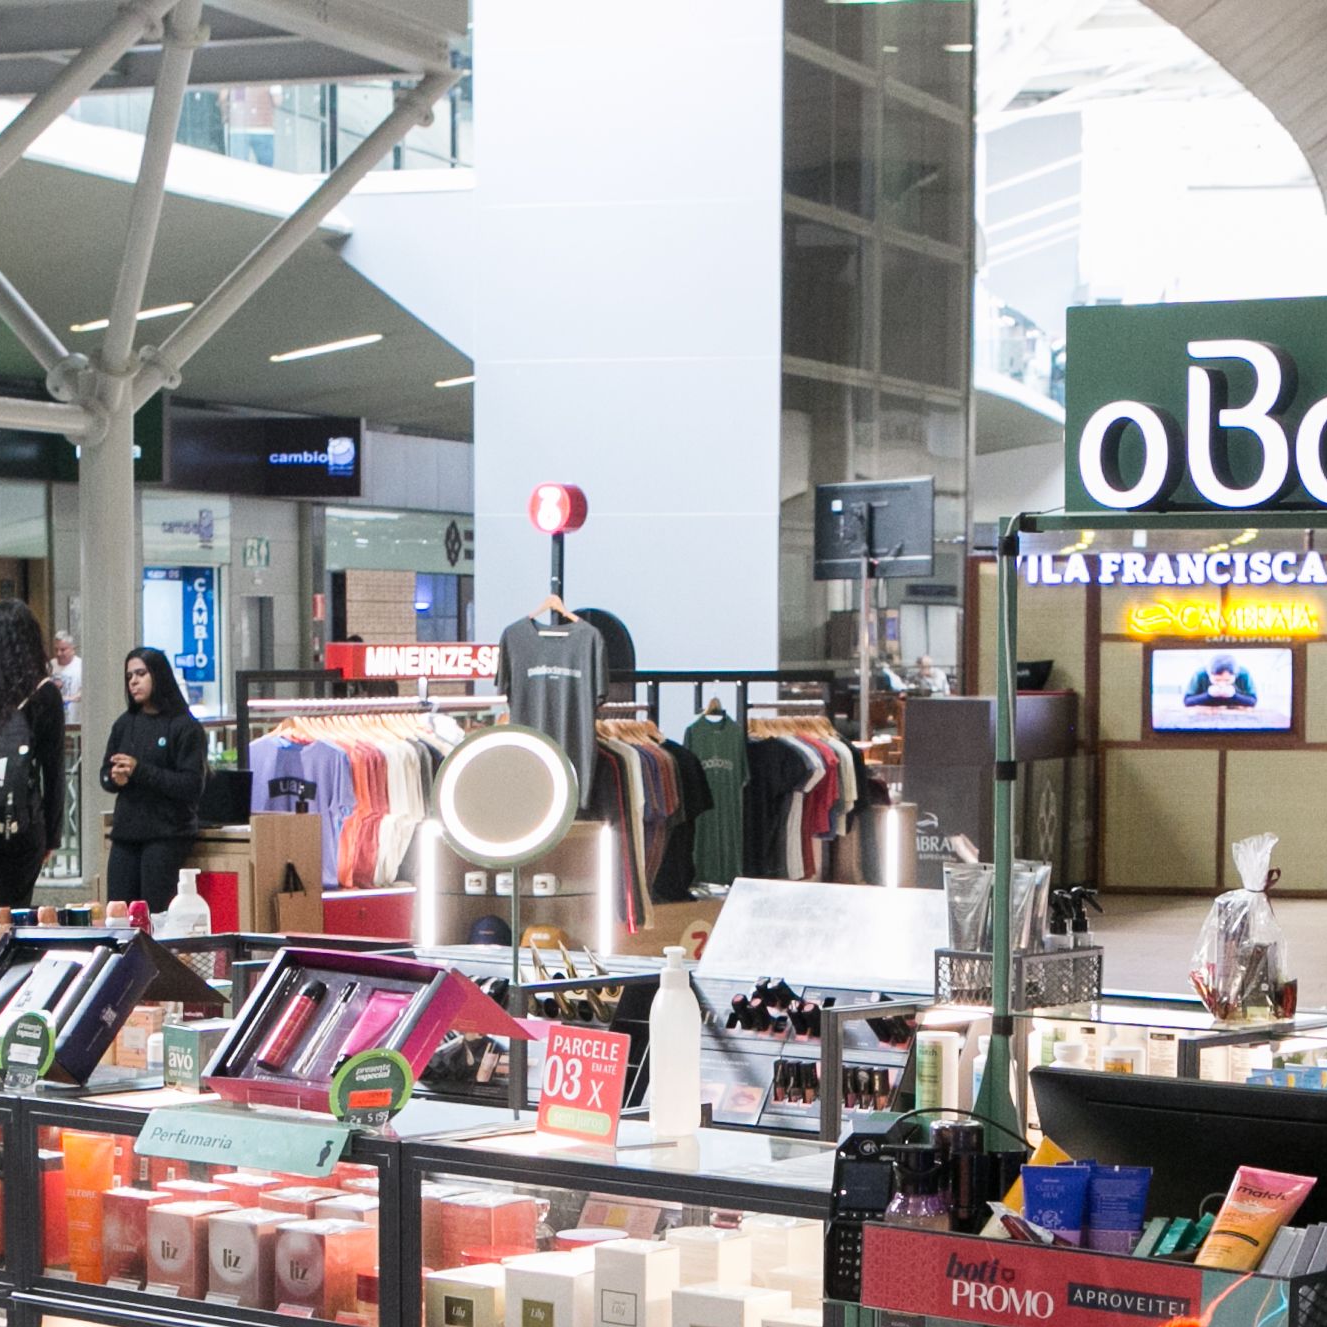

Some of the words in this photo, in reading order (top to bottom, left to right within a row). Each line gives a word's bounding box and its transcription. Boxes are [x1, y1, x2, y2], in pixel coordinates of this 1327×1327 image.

[269, 452, 329, 464] cambio
[1015, 553, 1090, 585] ILA
[168, 1048, 193, 1070] avó
[553, 1035, 620, 1062] PARCELE
[356, 1064, 391, 1075] presente
[356, 1071, 390, 1082] especial
[591, 1062, 603, 1073] EM
[604, 1063, 617, 1076] ATÉ
[543, 1055, 583, 1101] 03
[587, 1079, 604, 1108] X
[149, 1126, 233, 1150] Perfumaria
[161, 1240, 178, 1259] liz
[223, 1248, 241, 1269] liz
[290, 1260, 308, 1282] liz
[946, 1252, 1000, 1284] boti
[952, 1278, 1054, 1320] PROMO
[1073, 1288, 1186, 1317] APROVEITE!
[452, 1305, 466, 1320] Lily
[530, 1308, 546, 1322] Lily
